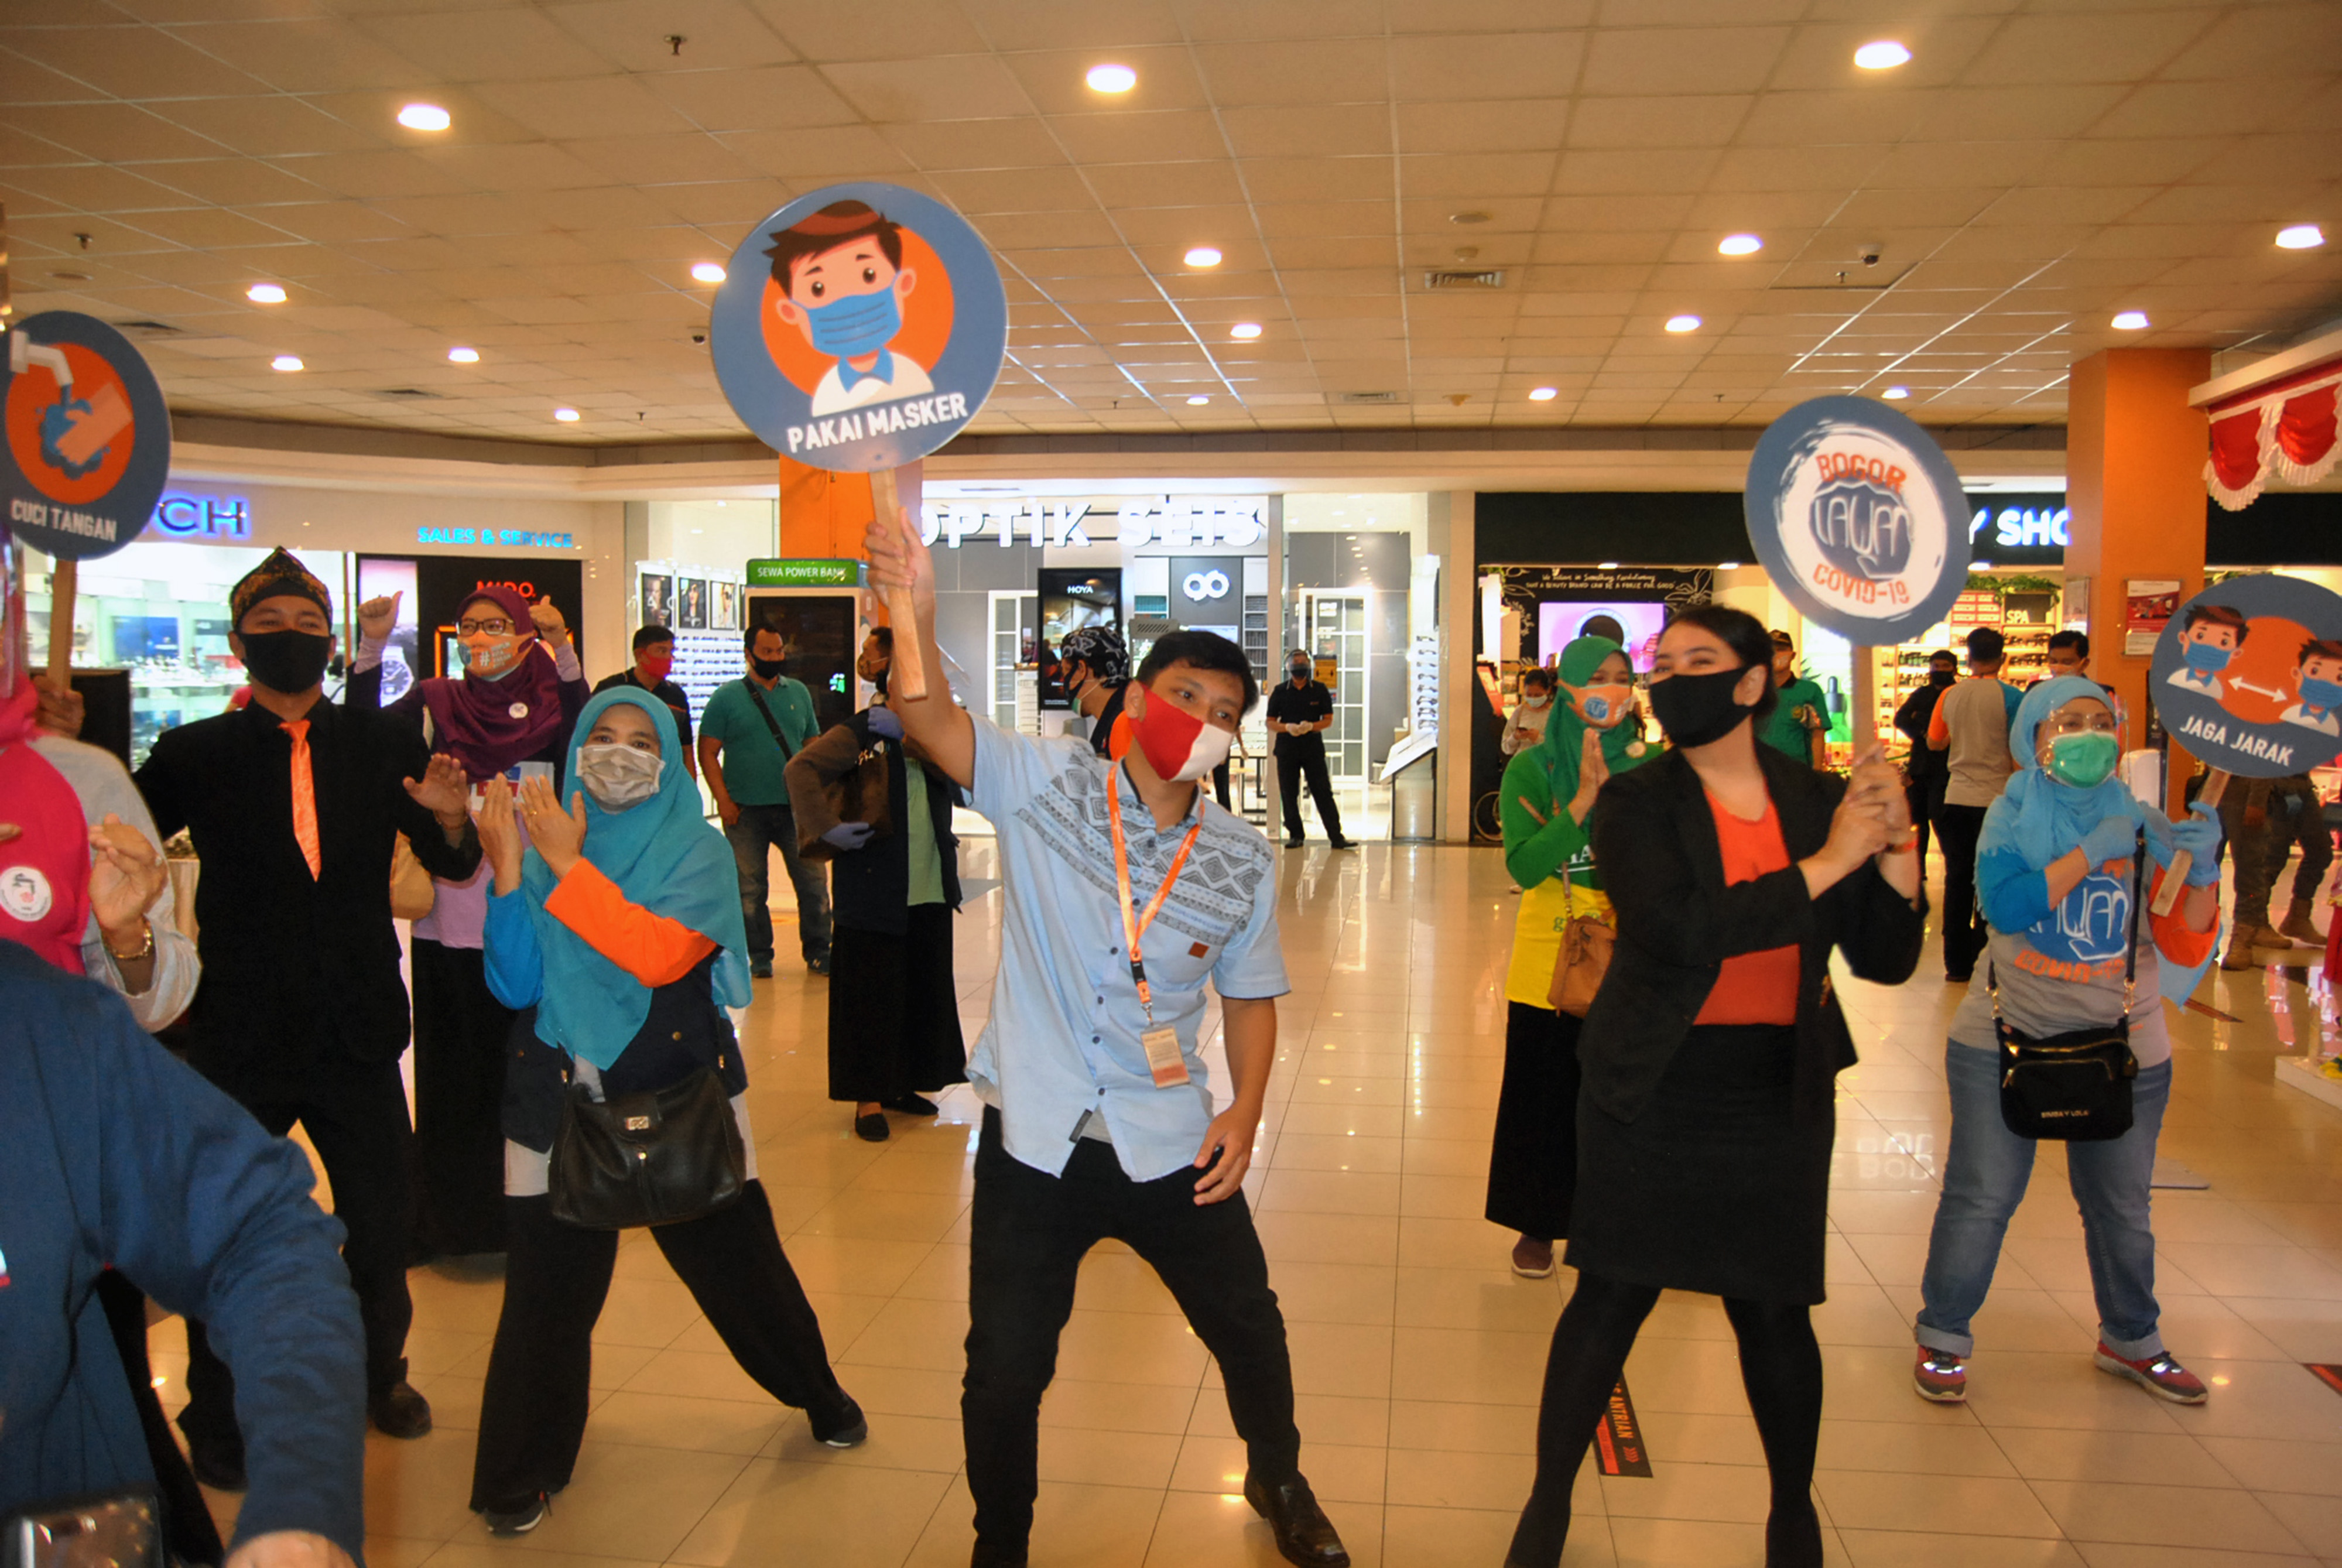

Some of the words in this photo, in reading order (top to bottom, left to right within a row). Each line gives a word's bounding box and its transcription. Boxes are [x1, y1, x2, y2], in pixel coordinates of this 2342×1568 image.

[787, 416, 863, 453] PAKAI
[868, 392, 968, 434] MASKER
[1816, 452, 1907, 494] BOGOR
[11, 499, 47, 526] CUCI
[52, 507, 116, 542] TANGAN
[418, 526, 475, 545] SALES
[482, 529, 495, 545] &
[500, 530, 573, 547] SERVICE
[758, 567, 783, 577] SEWA
[786, 567, 819, 577] POWER
[1067, 586, 1094, 594] HOYA
[1813, 563, 1910, 605] COVID-19
[2006, 610, 2029, 624] SPA
[2179, 715, 2226, 745] JAGA
[2230, 732, 2294, 766] JARAK
[1610, 1396, 1634, 1439] ANTRIAN
